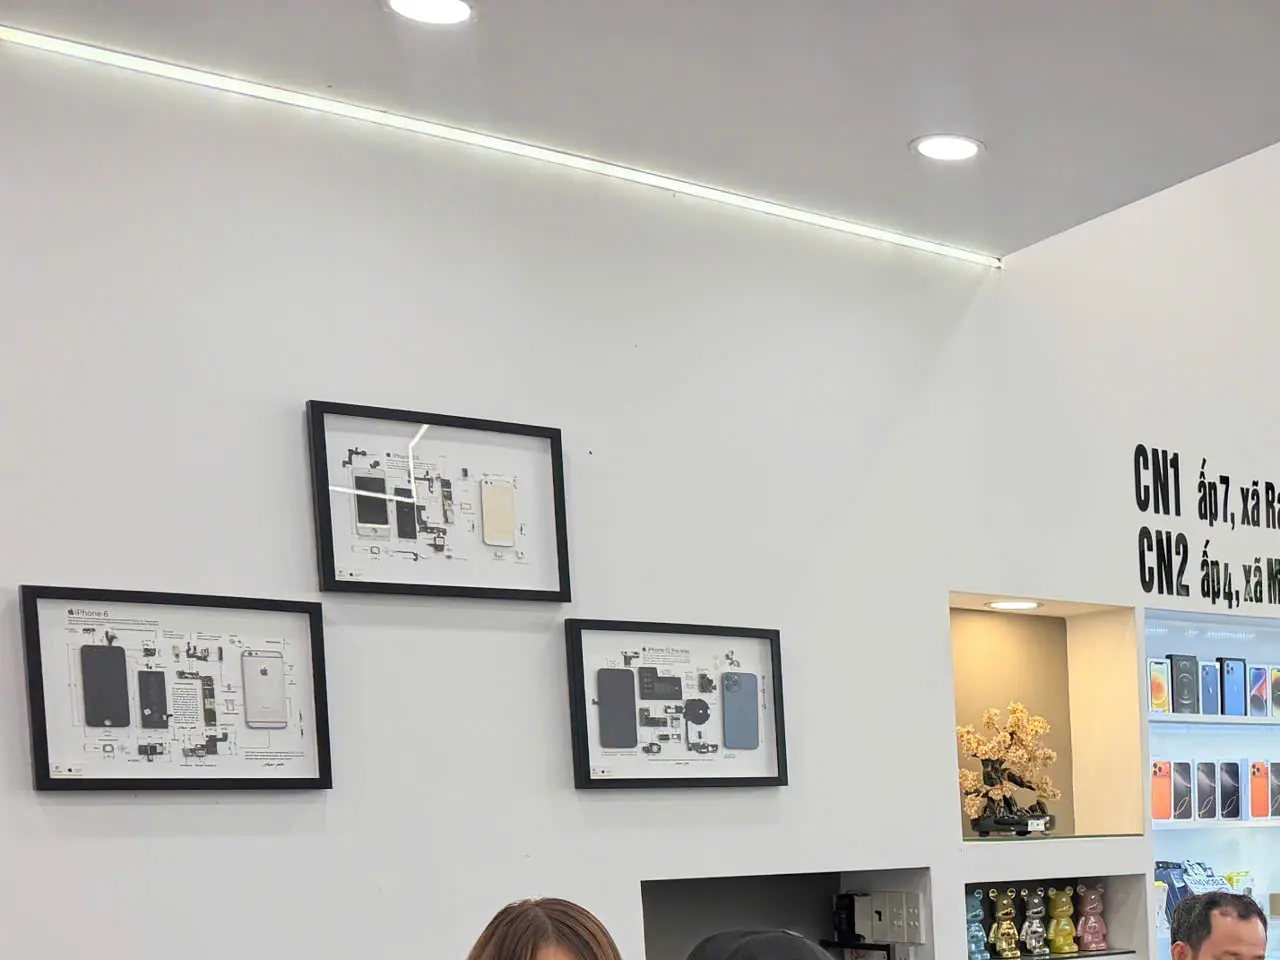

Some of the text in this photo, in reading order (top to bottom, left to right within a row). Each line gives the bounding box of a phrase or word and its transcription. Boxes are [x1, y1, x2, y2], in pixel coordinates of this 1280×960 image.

[1134, 443, 1182, 517] CN1
[1240, 480, 1261, 527] xã
[1138, 525, 1190, 597] CN2
[1242, 557, 1263, 603] xã
[75, 608, 109, 618] iPhone 6
